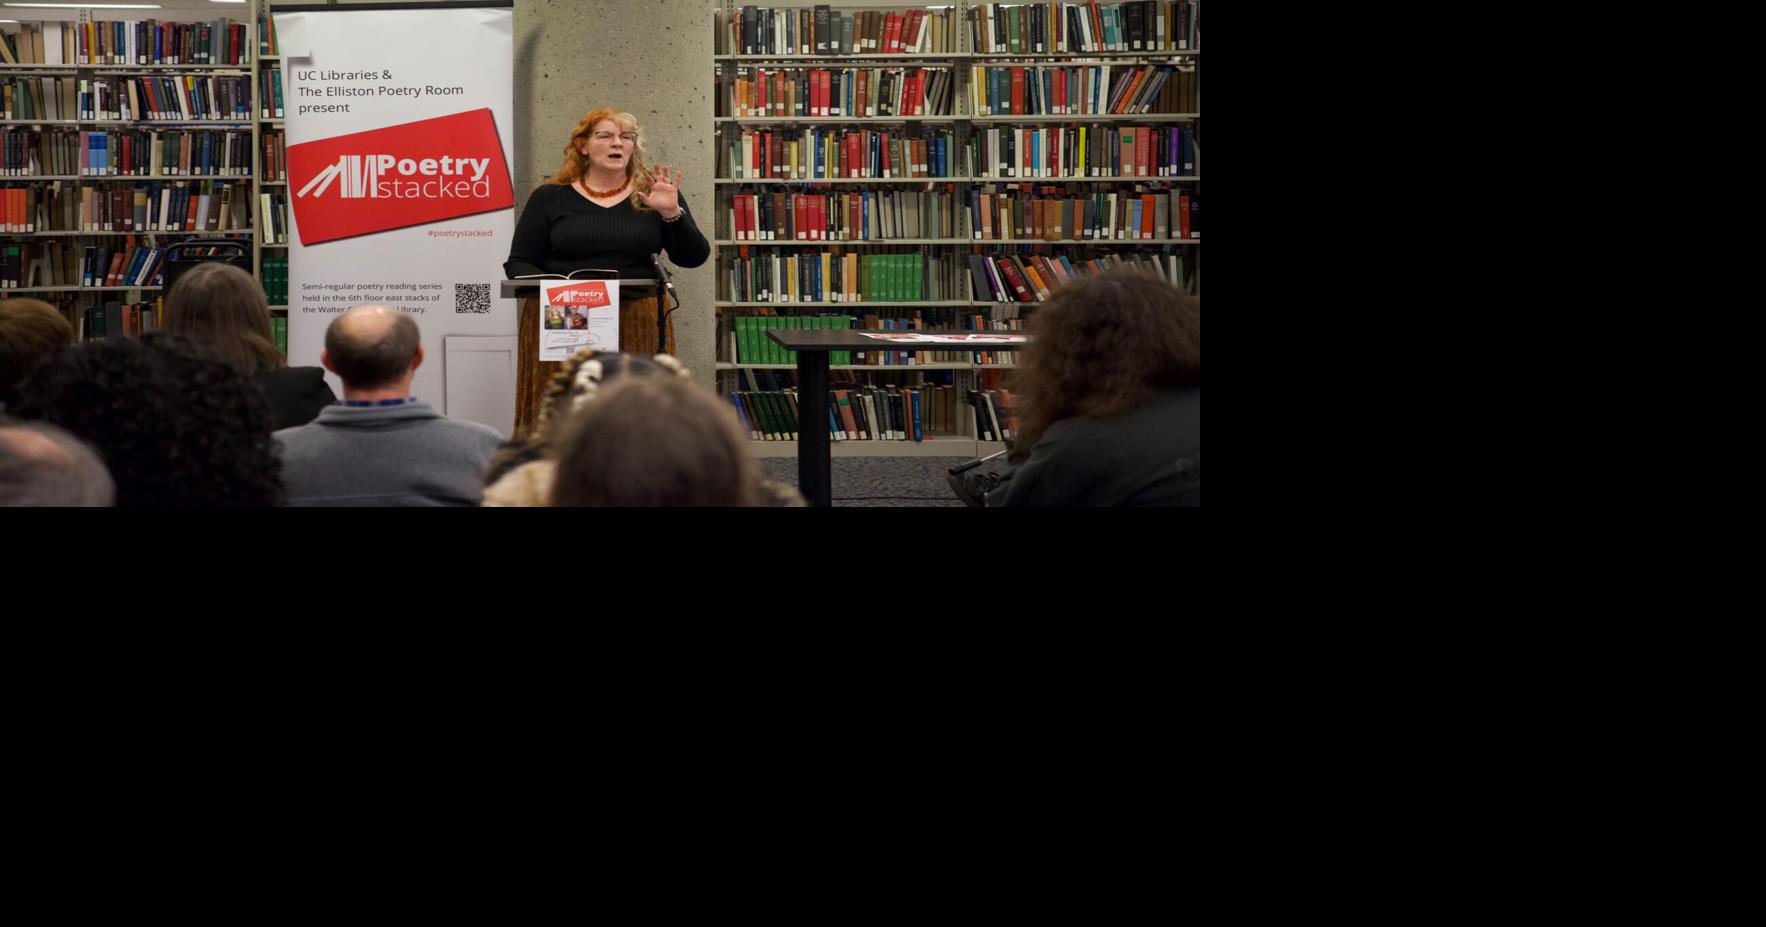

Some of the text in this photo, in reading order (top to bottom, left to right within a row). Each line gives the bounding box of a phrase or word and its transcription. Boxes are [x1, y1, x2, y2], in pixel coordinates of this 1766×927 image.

[298, 69, 393, 81] UC Libraries &
[298, 85, 464, 98] The Elliston Poetry Room
[298, 103, 351, 115] present
[377, 154, 490, 182] Poetry
[377, 175, 490, 198] stacked
[428, 229, 493, 238] #poetrystacked
[302, 283, 355, 291] Semi-regular
[386, 283, 417, 291] reading
[302, 294, 321, 302] held
[322, 294, 330, 302] in
[331, 294, 346, 302] the
[348, 294, 362, 302] 6th
[364, 294, 383, 302] floor
[404, 294, 430, 302] stacks
[431, 294, 440, 302] of
